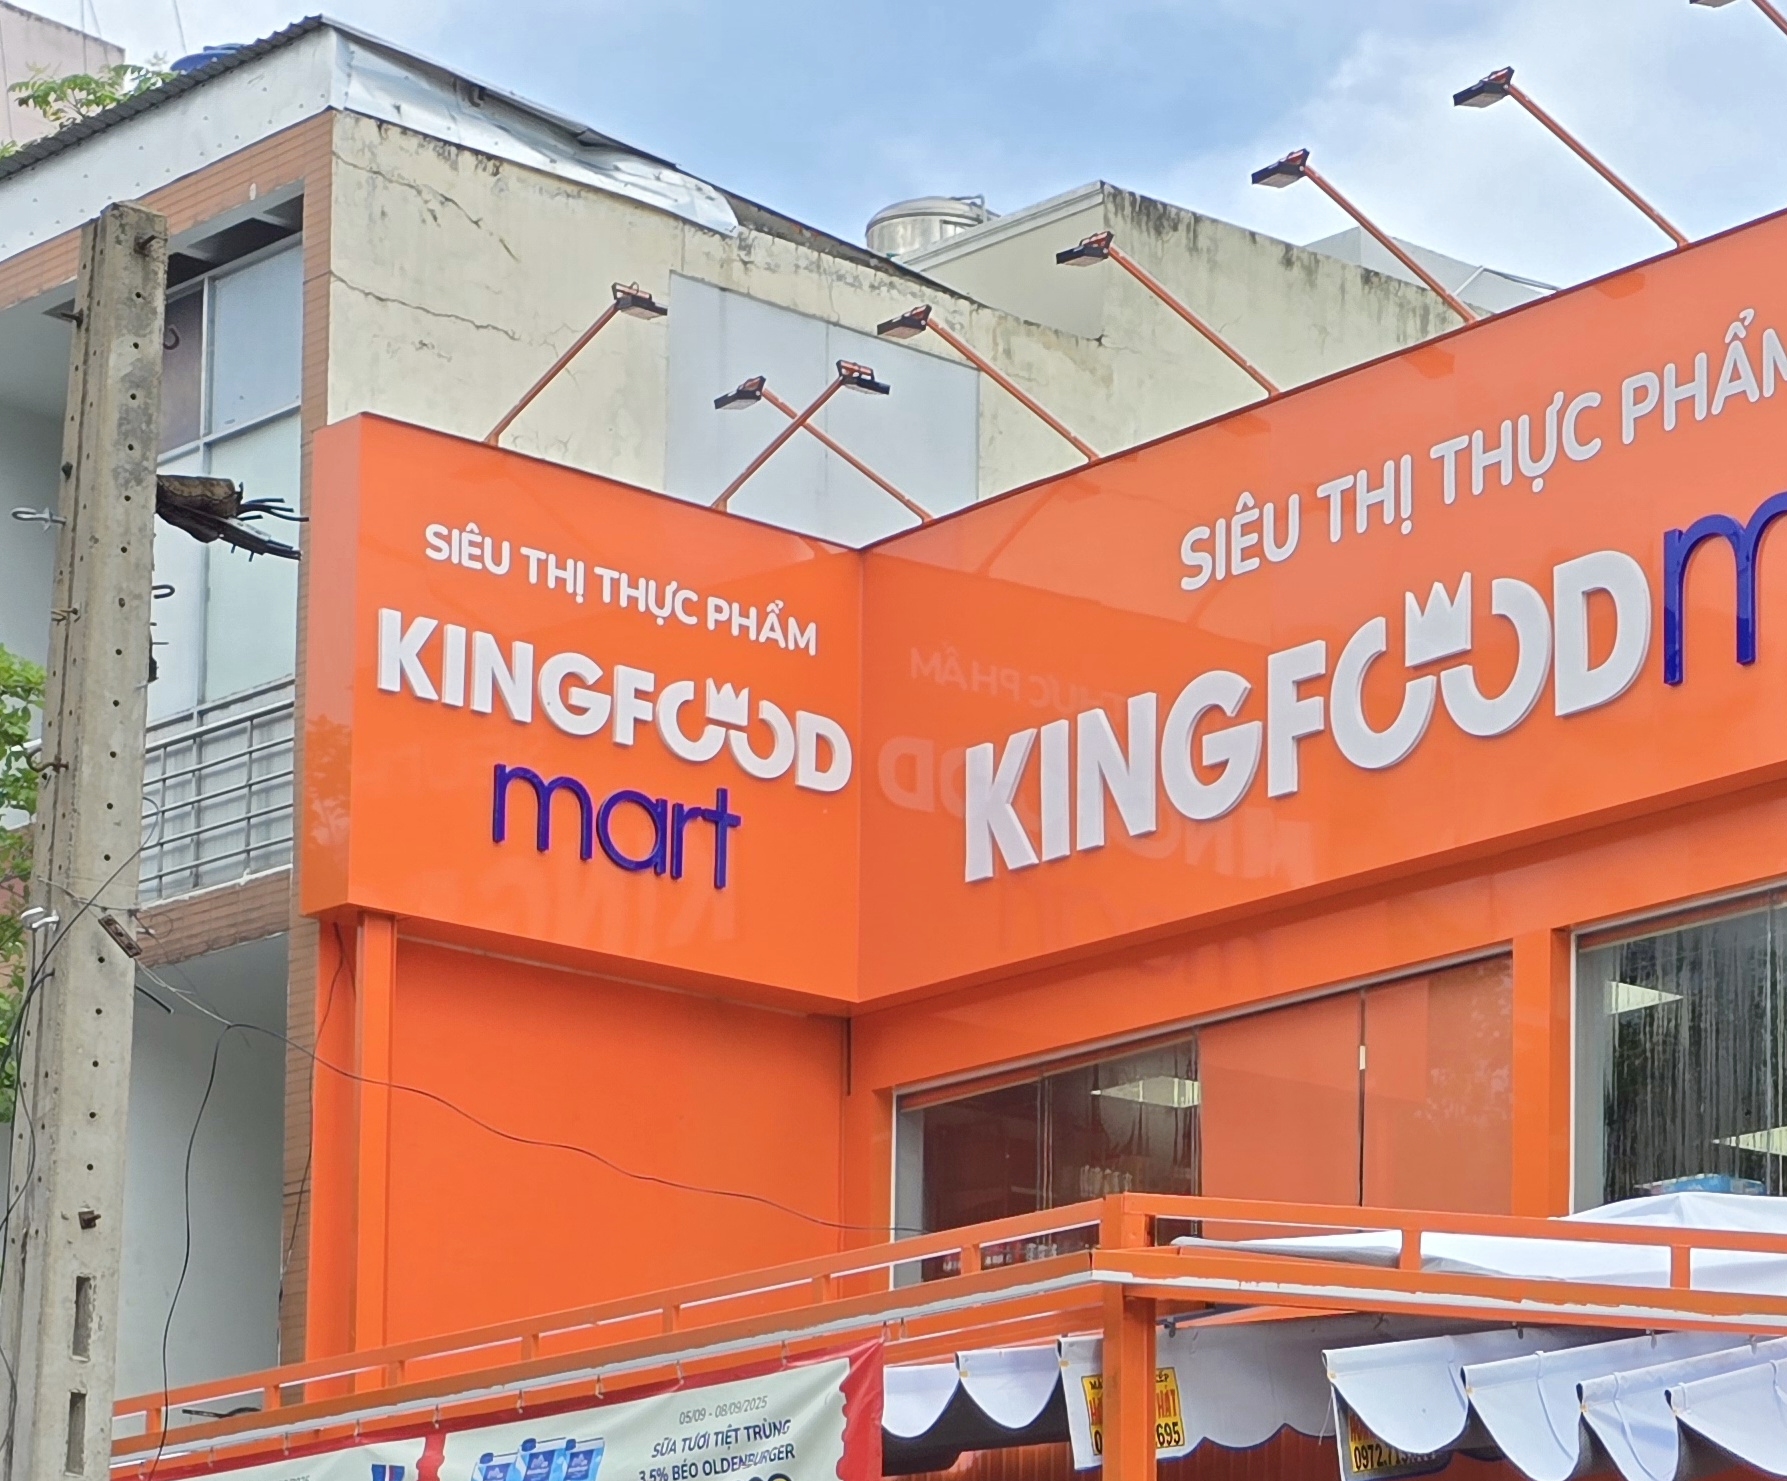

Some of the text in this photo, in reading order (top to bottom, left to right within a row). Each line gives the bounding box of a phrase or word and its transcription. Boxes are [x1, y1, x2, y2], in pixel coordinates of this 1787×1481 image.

[1179, 490, 1299, 593] SIÊU
[1317, 454, 1414, 535] THỊ
[1430, 389, 1602, 494] THỰC
[425, 523, 818, 657] SIÊU THỊ THỰC PHẨM
[376, 607, 853, 793] KINGFOOD
[492, 762, 742, 890] mart
[651, 1419, 792, 1458] SỮA TƯƠI TIỆT TRÙNG
[671, 1459, 699, 1481] BÉO
[702, 1443, 796, 1477] OLDENBURGER
[679, 1396, 768, 1425] 05/09 08/09/2025
